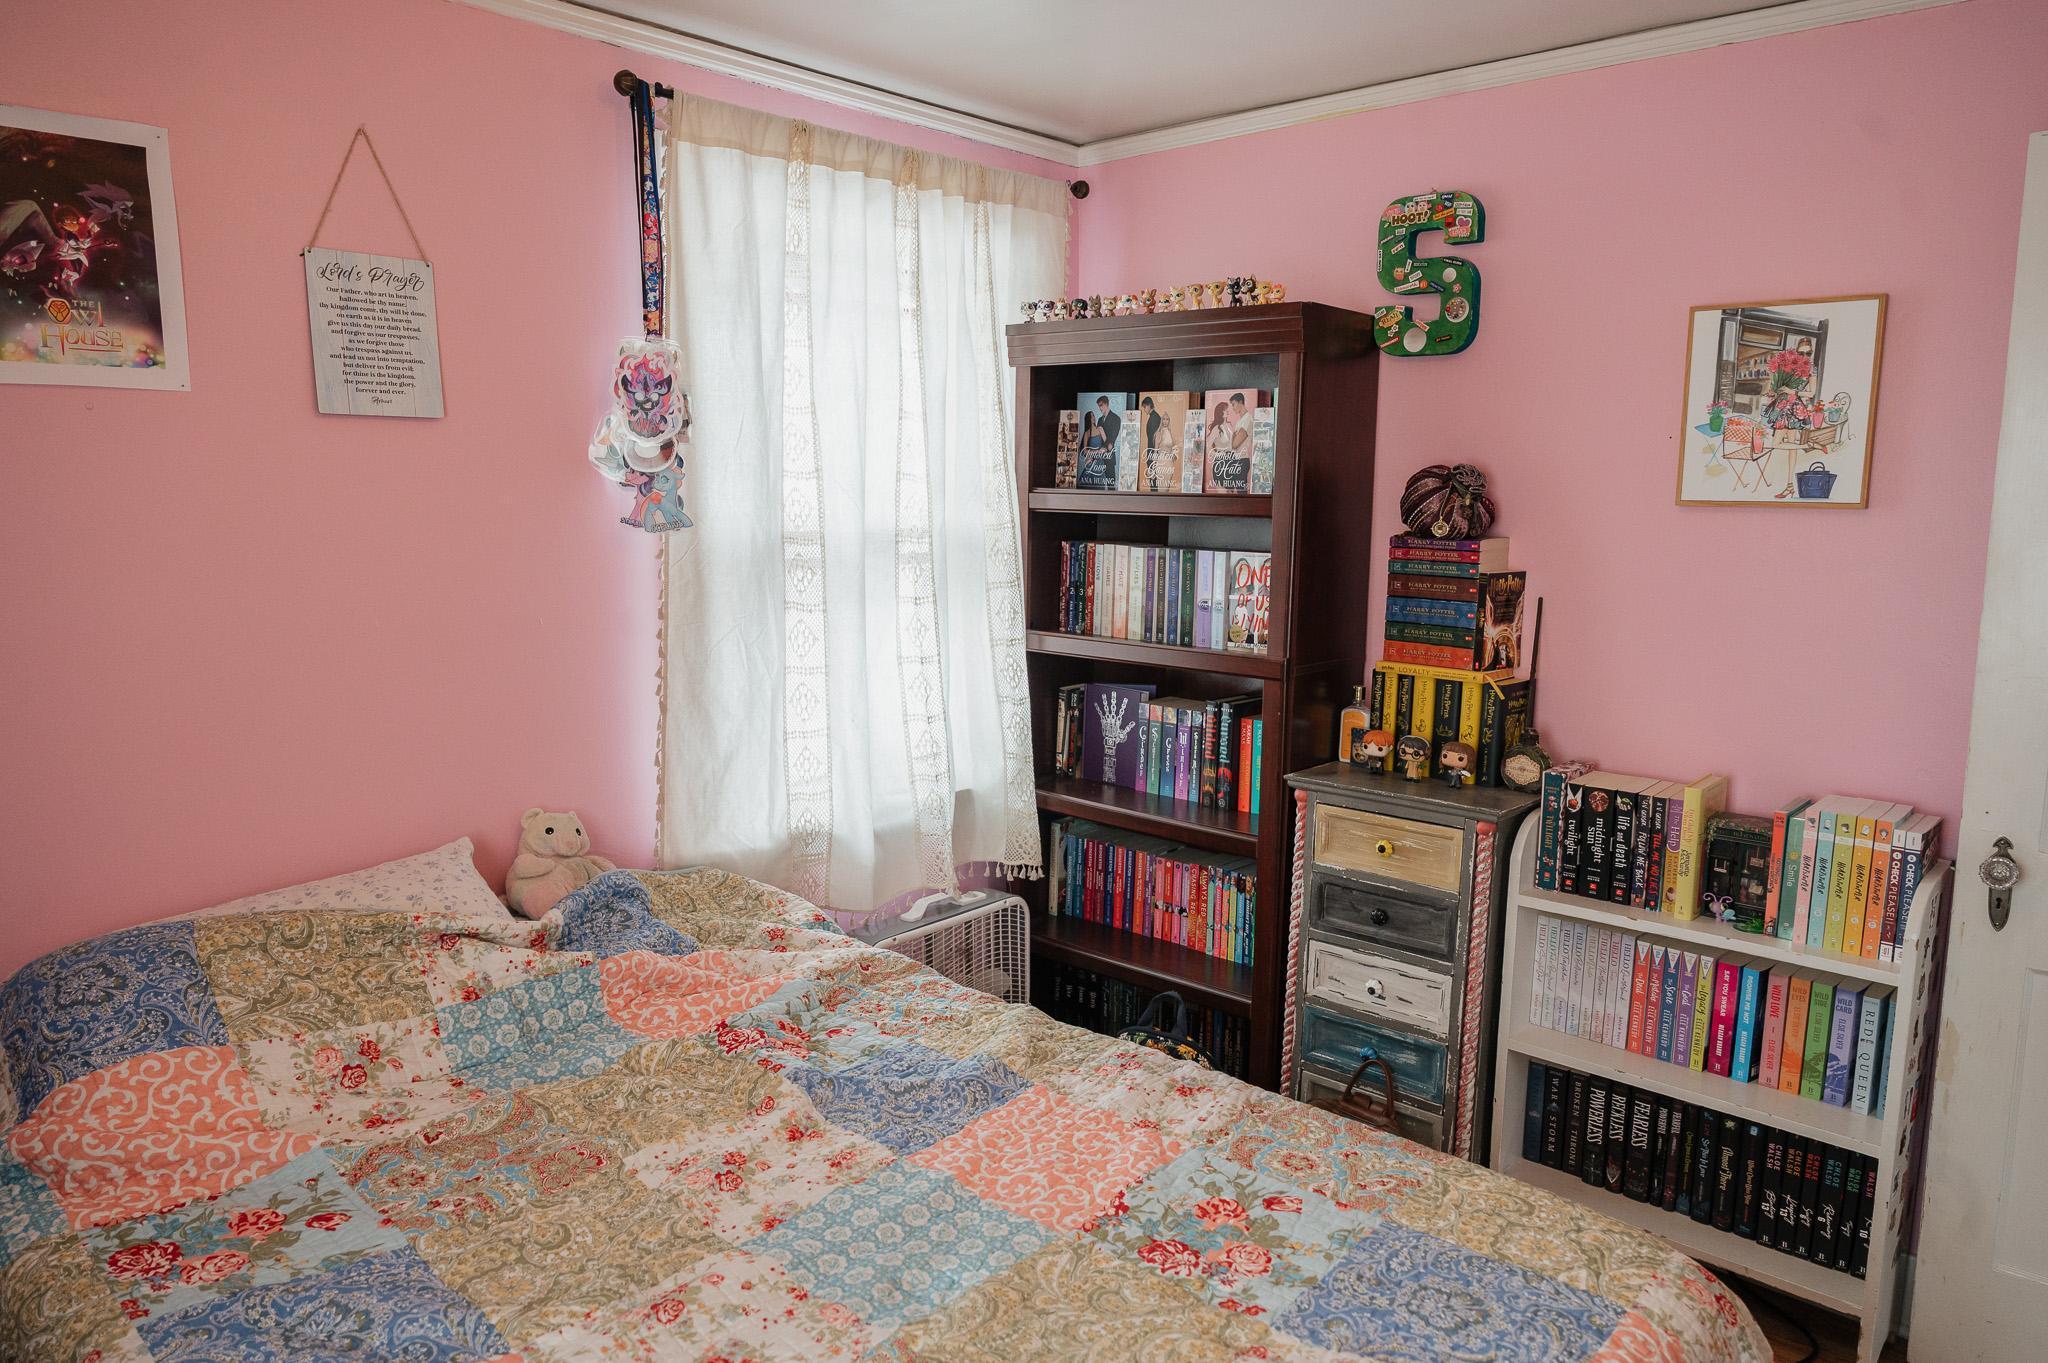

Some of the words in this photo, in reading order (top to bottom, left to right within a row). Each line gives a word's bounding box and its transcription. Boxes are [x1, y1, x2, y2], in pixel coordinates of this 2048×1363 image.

[1391, 210, 1430, 226] HOOT!
[316, 262, 362, 281] Lord's
[368, 266, 424, 292] Prayer
[339, 296, 368, 304] hallowed
[340, 288, 362, 296] Father,
[72, 300, 95, 308] THE
[1080, 446, 1116, 462] Twisted
[1142, 446, 1178, 462] Twisted
[1208, 447, 1247, 462] Twisted
[1085, 459, 1107, 476] Love
[1144, 460, 1175, 479] Games
[1214, 459, 1242, 479] Hate
[1081, 477, 1092, 485] ANA
[1094, 477, 1115, 486] HUANG
[1143, 479, 1155, 487] ANA
[1156, 479, 1177, 487] HUANG
[1222, 480, 1246, 488] HUANG
[1080, 588, 1084, 596] 3
[1238, 593, 1252, 608] OF
[1398, 667, 1430, 676] LOYALTY
[1205, 714, 1217, 760] Gilded
[1220, 715, 1232, 764] Cursed
[1139, 726, 1147, 777] Cinder
[1179, 732, 1188, 786] Winter
[1545, 816, 1554, 849] TWILIGHT
[1618, 816, 1630, 830] life
[1564, 820, 1578, 856] twilight
[1587, 826, 1596, 844] sun
[1591, 818, 1606, 864] midnight
[1616, 832, 1625, 843] and
[1638, 832, 1646, 856] FOLLOW
[1653, 832, 1662, 848] TELL
[1668, 826, 1680, 846] Help
[1614, 844, 1628, 868] death
[1636, 856, 1645, 868] ME
[1652, 850, 1660, 861] ME
[1635, 868, 1644, 888] BACK
[1650, 864, 1659, 876] NO
[1786, 864, 1798, 887] Smile
[1649, 877, 1658, 895] LIES
[1200, 902, 1208, 917] RED
[1539, 923, 1548, 948] HELLO
[1611, 942, 1619, 967] HELLO
[1622, 944, 1632, 970] HELLO
[1636, 978, 1644, 995] Deal
[1665, 984, 1676, 1004] Score
[1722, 983, 1730, 996] YOU
[1746, 976, 1754, 1000] PROMISE
[1772, 984, 1782, 1002] WILD
[1682, 990, 1692, 1006] Goal
[1696, 990, 1708, 1016] Legacy
[1720, 996, 1728, 1017] SWEAR
[1744, 1001, 1752, 1011] ME
[1837, 998, 1852, 1006] WILD
[1770, 1002, 1781, 1018] LOVE
[1836, 1006, 1852, 1014] CARD
[1838, 1018, 1846, 1032] ELSIE
[1864, 1010, 1876, 1036] RED
[1768, 1040, 1776, 1053] ELSIE
[1836, 1032, 1845, 1050] SILVER
[1856, 1052, 1870, 1104] QUEEN
[1548, 1077, 1560, 1100] WAR
[1572, 1081, 1582, 1117] BROKEN
[1586, 1087, 1606, 1145] POWERLESS
[1609, 1093, 1626, 1142] RECKLESS
[1632, 1100, 1651, 1150] FEARLESS
[1548, 1115, 1557, 1152] STORM
[1568, 1129, 1578, 1168] THRONE
[1766, 1143, 1776, 1169] WALSH
[1774, 1144, 1782, 1171] CHLOE
[1722, 1146, 1734, 1171] Almost
[1786, 1148, 1796, 1174] WALSH
[1794, 1150, 1802, 1177] CHLOE
[1699, 1164, 1708, 1178] Love
[1720, 1170, 1732, 1190] There
[1824, 1160, 1834, 1186] WALSH
[1832, 1161, 1842, 1188] CHLOE
[1762, 1202, 1770, 1211] 13
[1780, 1208, 1788, 1217] 13
[1859, 1229, 1869, 1239] 10
